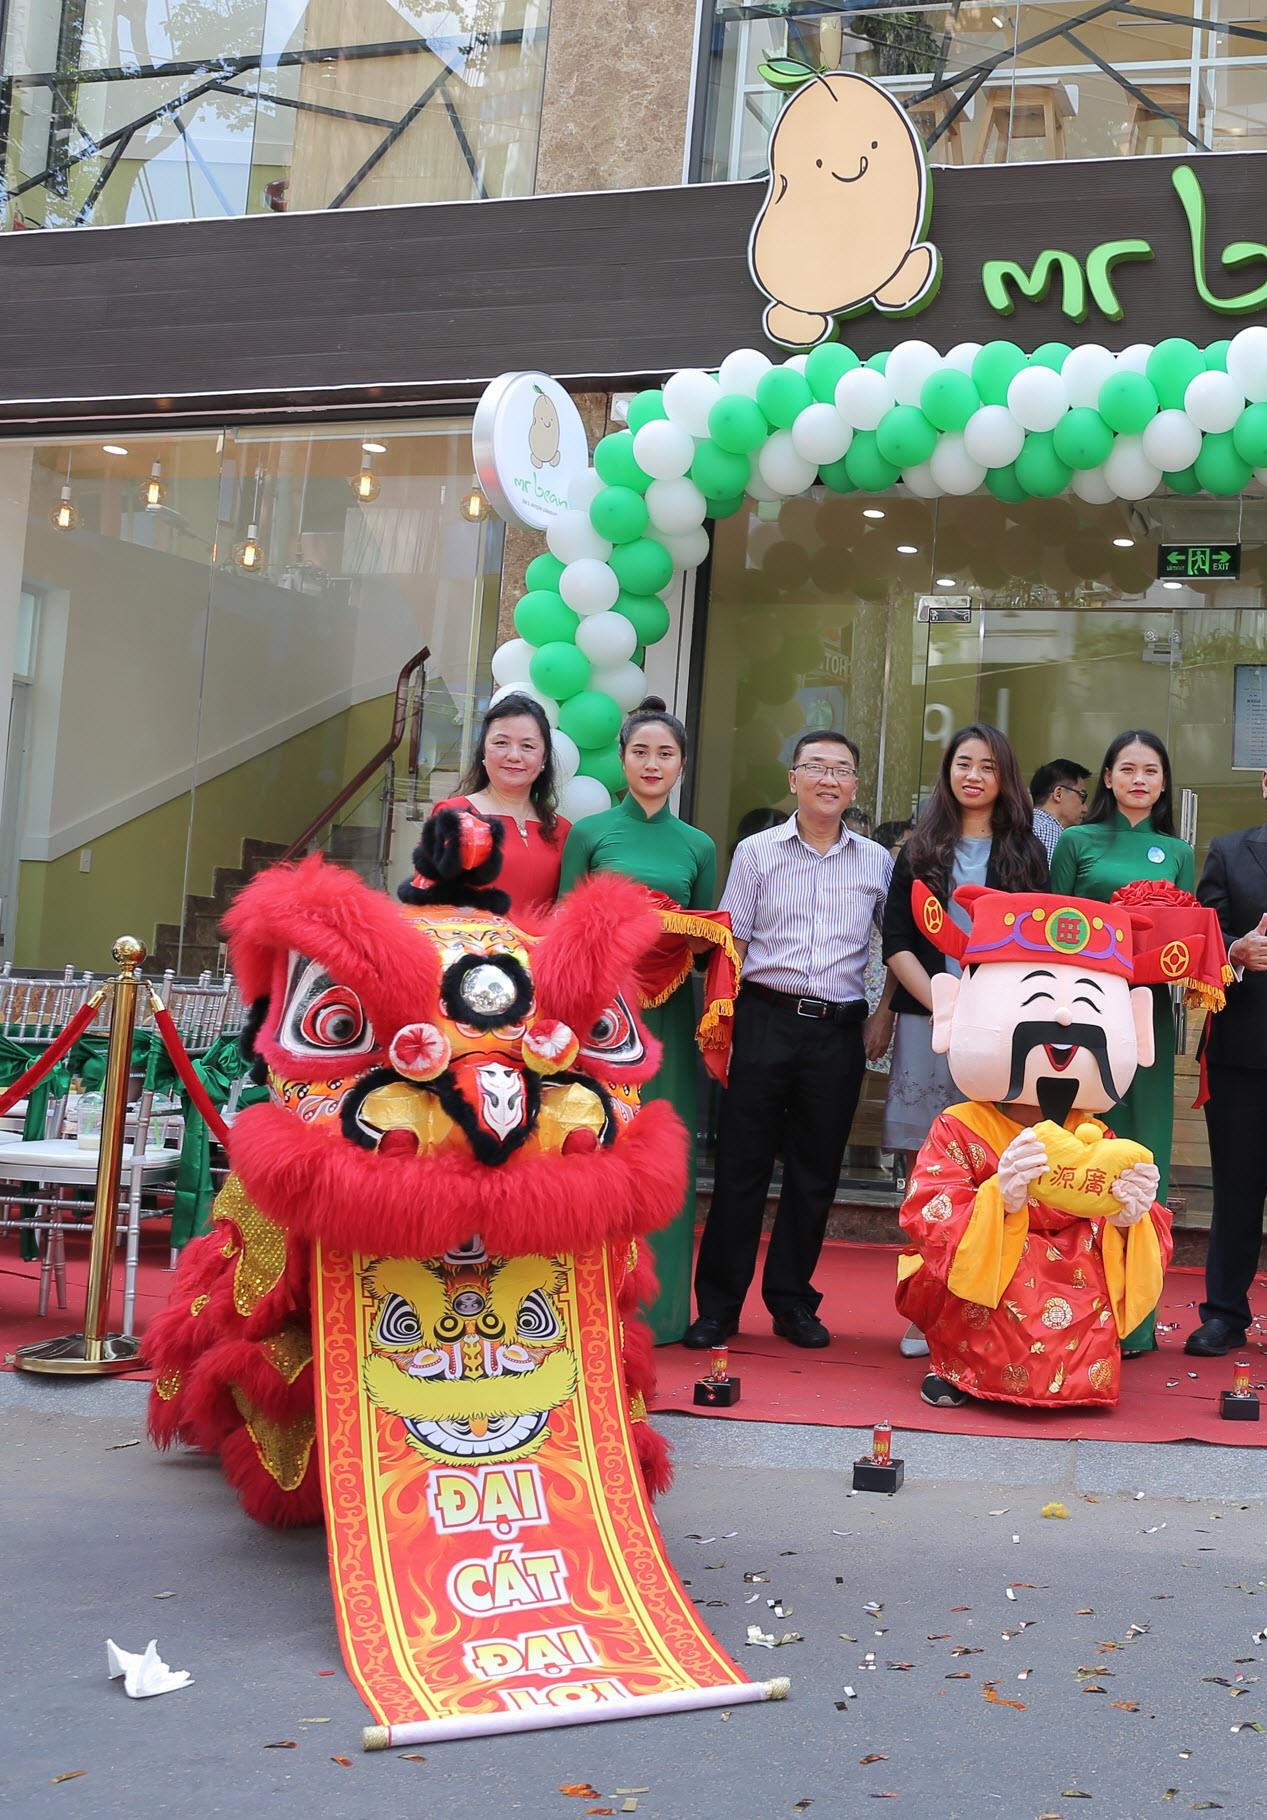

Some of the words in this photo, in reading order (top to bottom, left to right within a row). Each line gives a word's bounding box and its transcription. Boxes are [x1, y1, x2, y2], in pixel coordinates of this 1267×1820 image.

[981, 239, 1154, 323] mr
[514, 477, 532, 493] mr
[533, 471, 568, 509] bean
[1212, 562, 1230, 571] EXIT
[1056, 917, 1082, 944] 旺
[1036, 1163, 1121, 1197] 源廣
[432, 1466, 544, 1537] ĐẠI
[451, 1547, 564, 1614] CÁT
[469, 1628, 597, 1676] ĐẠI
